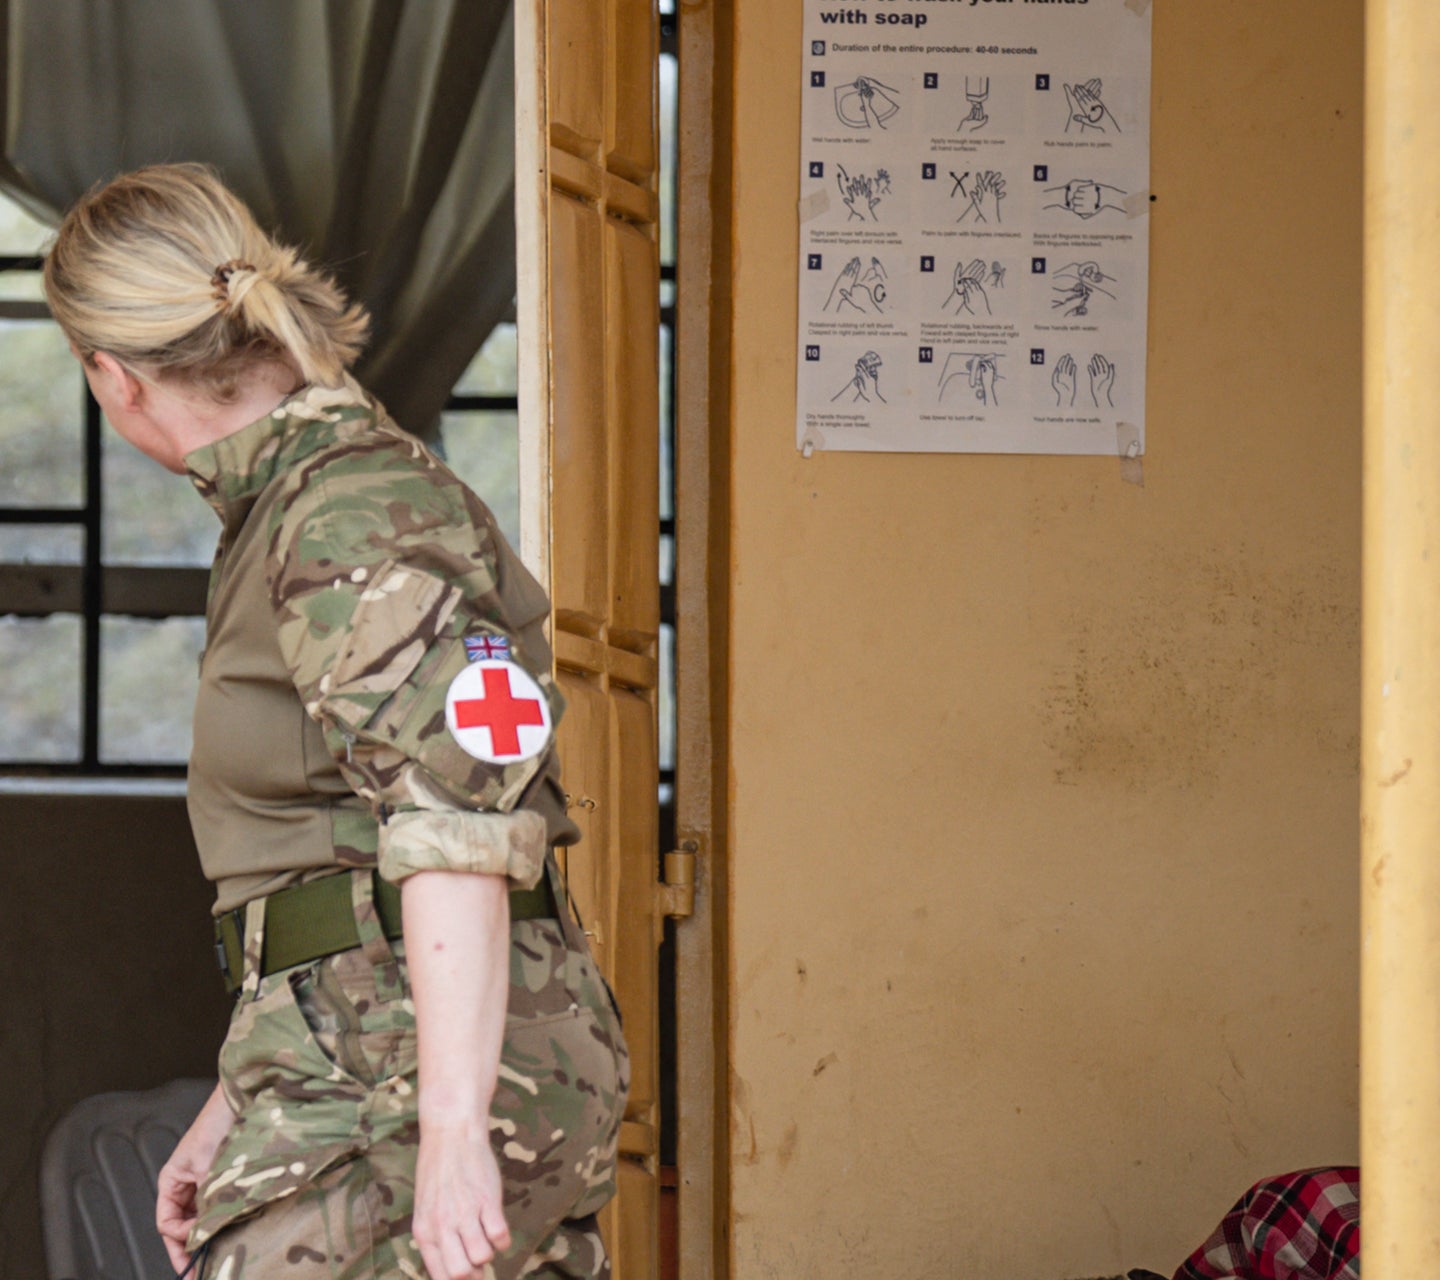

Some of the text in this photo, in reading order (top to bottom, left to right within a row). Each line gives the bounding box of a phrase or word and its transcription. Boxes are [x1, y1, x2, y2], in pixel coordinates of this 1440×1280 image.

[820, 8, 927, 28] with soap
[832, 43, 868, 52] Duration
[870, 43, 879, 53] of
[880, 44, 897, 53] the
[899, 44, 924, 53] entire
[926, 45, 973, 55] procedure:
[1001, 46, 1038, 55] seconds
